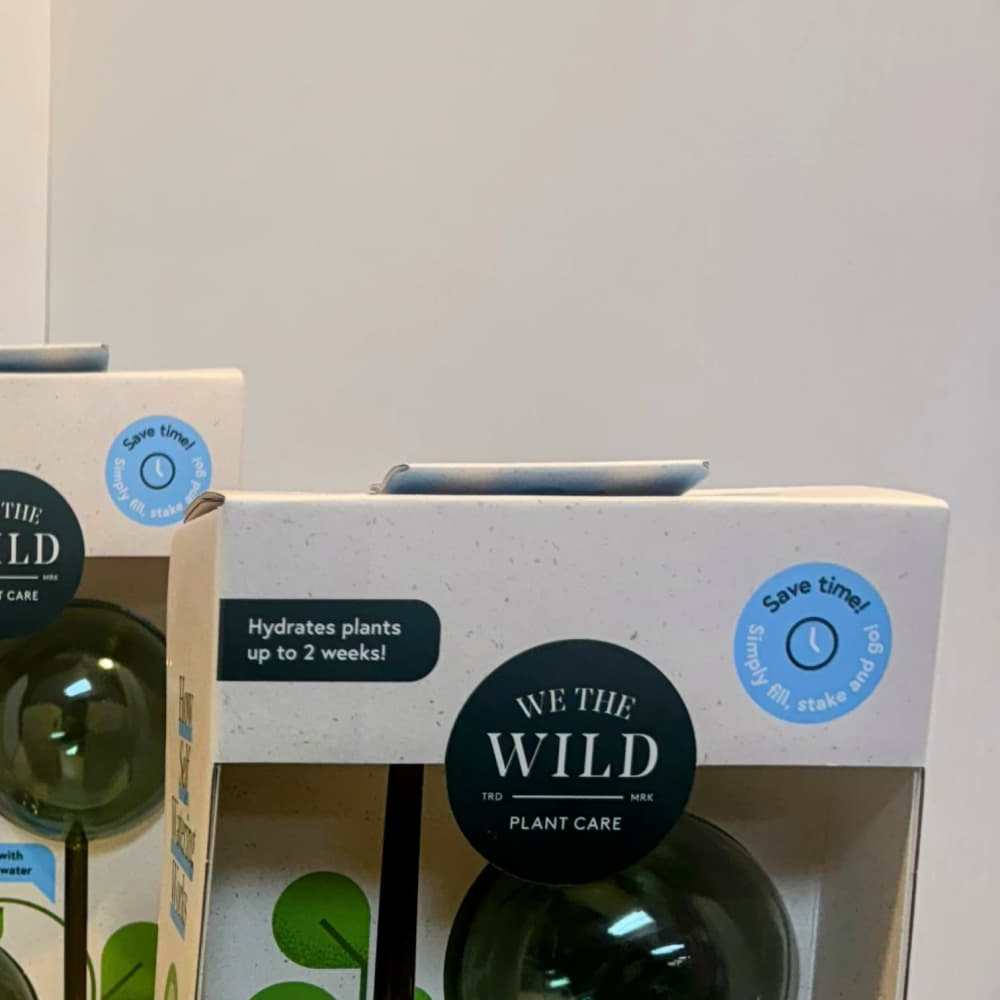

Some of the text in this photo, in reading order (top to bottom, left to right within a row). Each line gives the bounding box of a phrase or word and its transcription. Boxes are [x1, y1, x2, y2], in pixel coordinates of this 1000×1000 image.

[123, 424, 196, 451] Save time!
[113, 457, 129, 501] Simply
[130, 498, 145, 517] fill,
[151, 502, 183, 518] stake
[192, 456, 207, 478] go!
[1, 501, 43, 525] THE
[7, 590, 39, 601] CARE
[762, 576, 871, 615] Save time!
[248, 617, 401, 640] Hydrates plants
[248, 643, 386, 664] up to 2 weeks!
[744, 624, 884, 712] Simply fill, stake and go!
[516, 687, 636, 720] WE THE
[486, 732, 658, 778] WILD
[482, 792, 654, 802] TRD MRK
[509, 816, 622, 831] PLANT CARE
[0, 866, 32, 876] water
